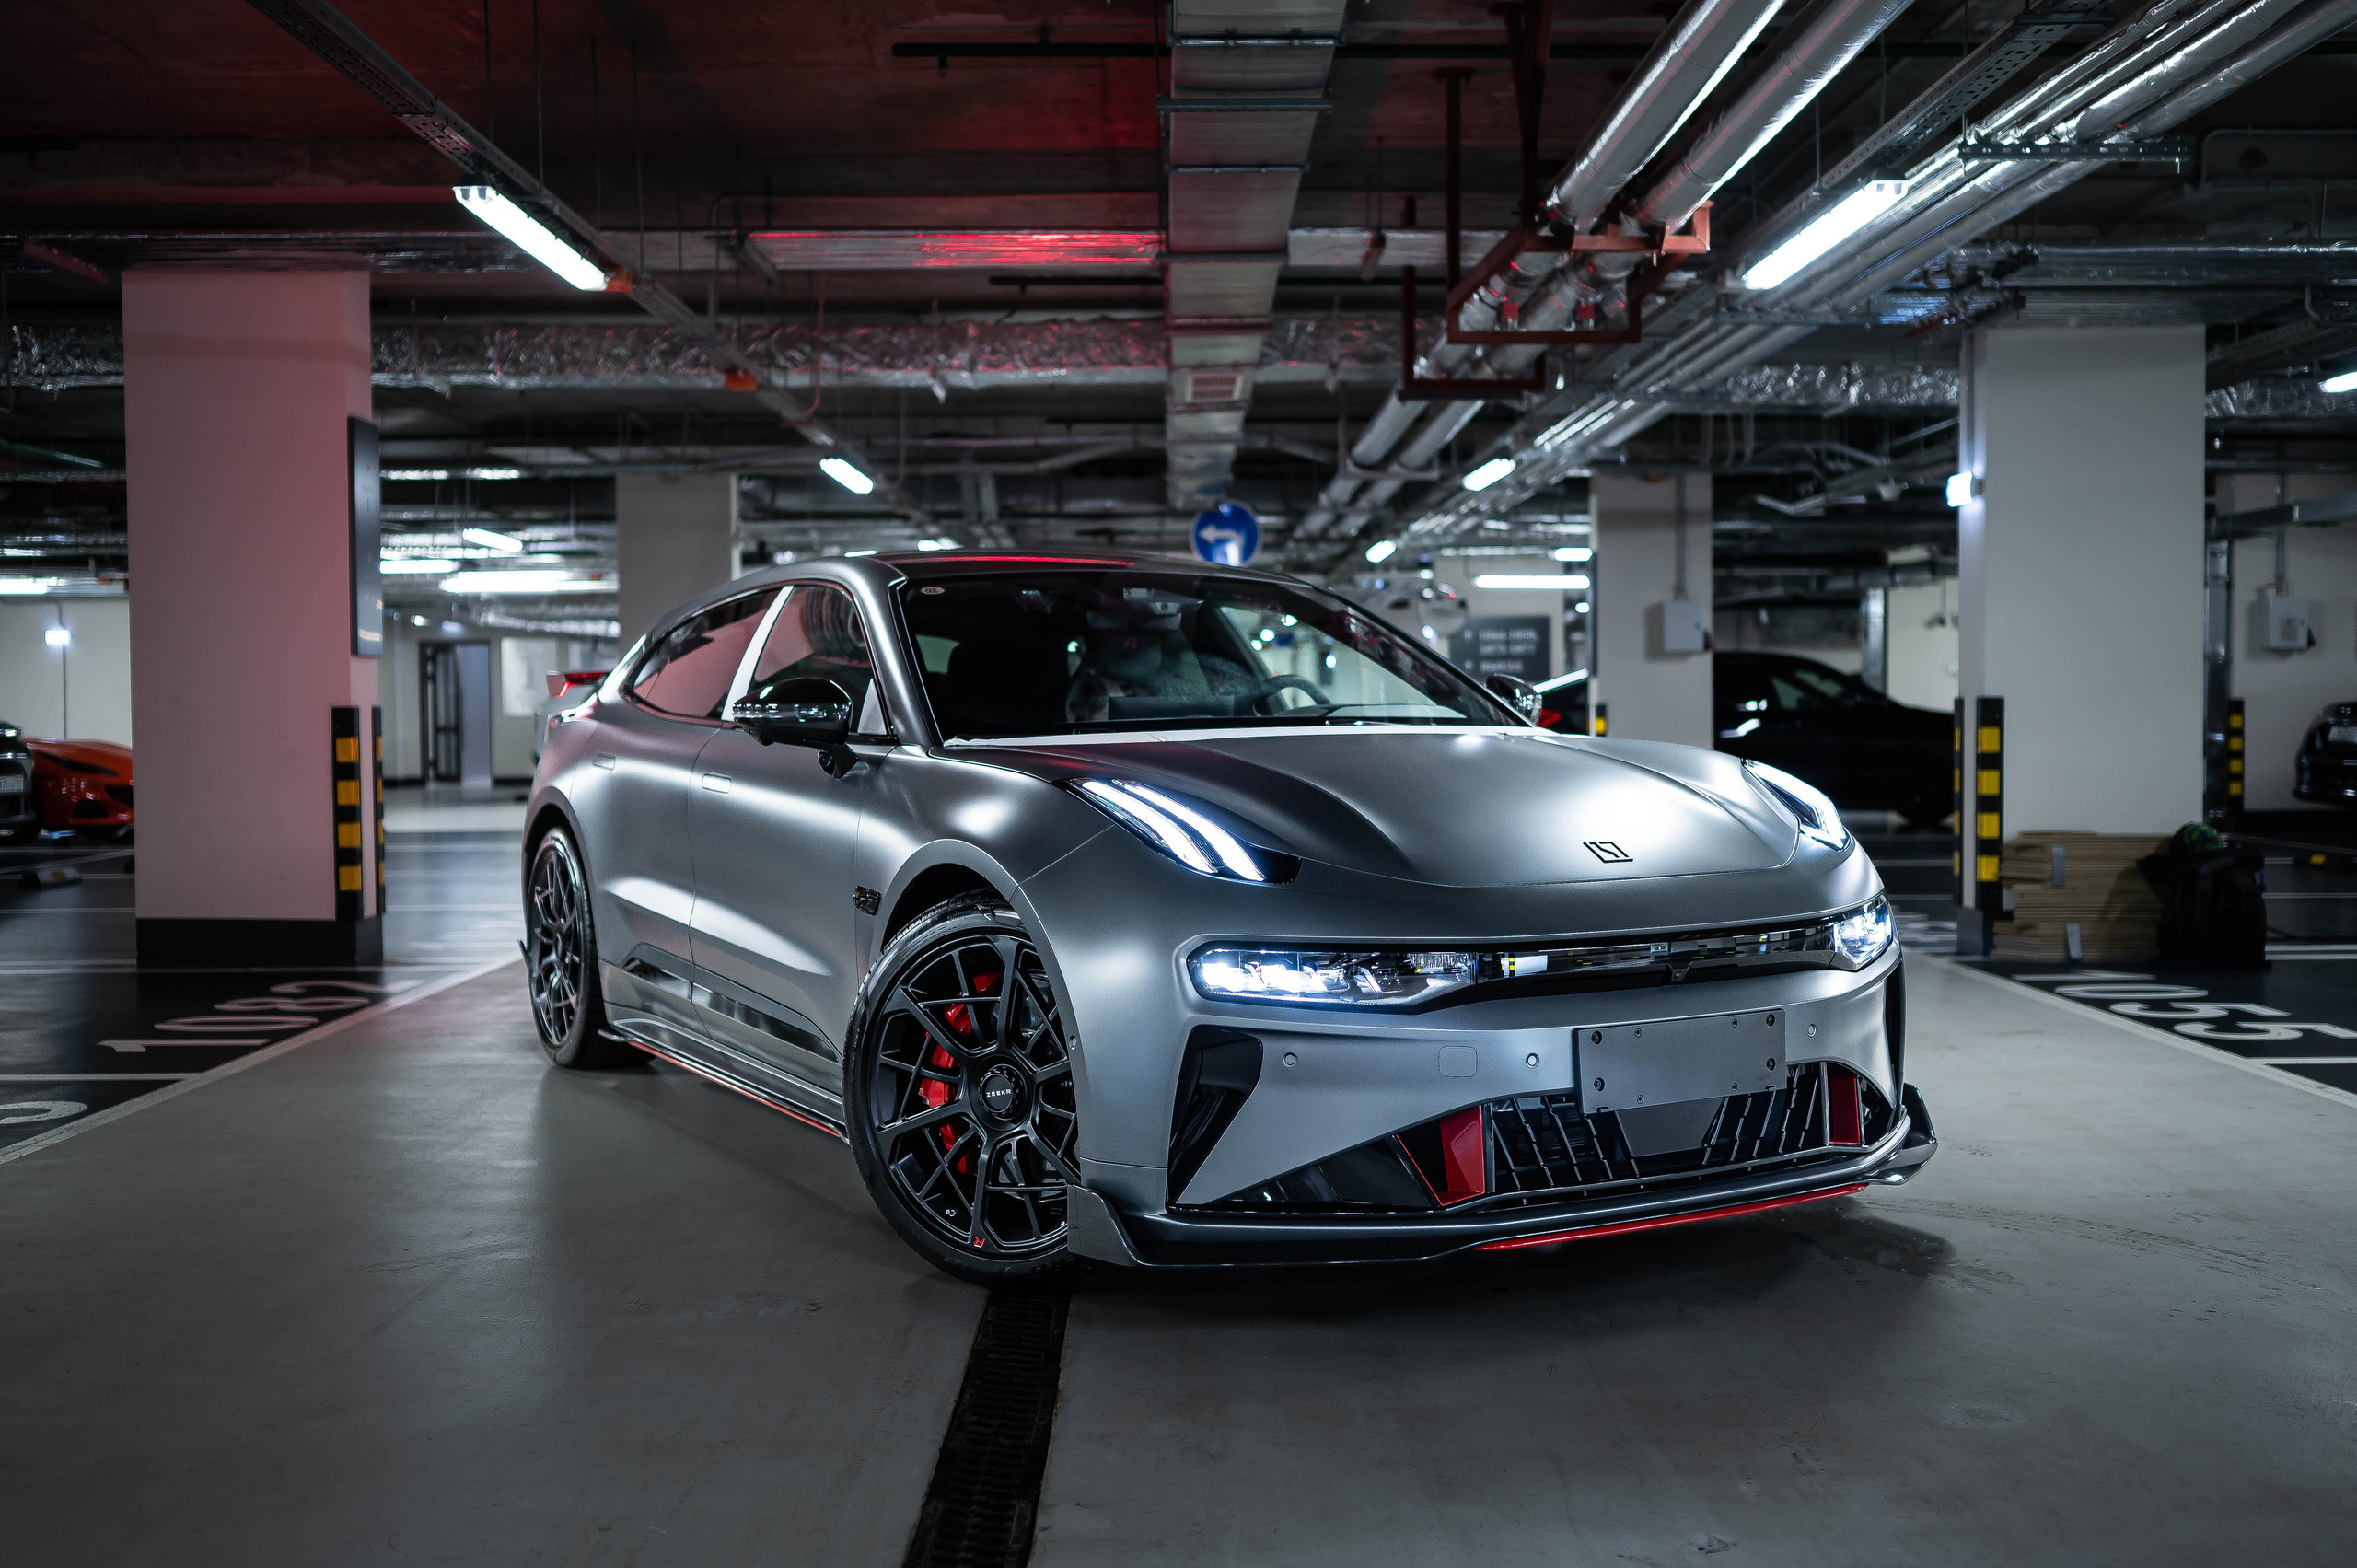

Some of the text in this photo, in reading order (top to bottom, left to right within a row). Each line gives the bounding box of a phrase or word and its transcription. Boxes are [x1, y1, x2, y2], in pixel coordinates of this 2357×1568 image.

[97, 980, 424, 1052] 1082
[2011, 969, 2357, 1041] 1055
[986, 1088, 1012, 1098] ZEEKR
